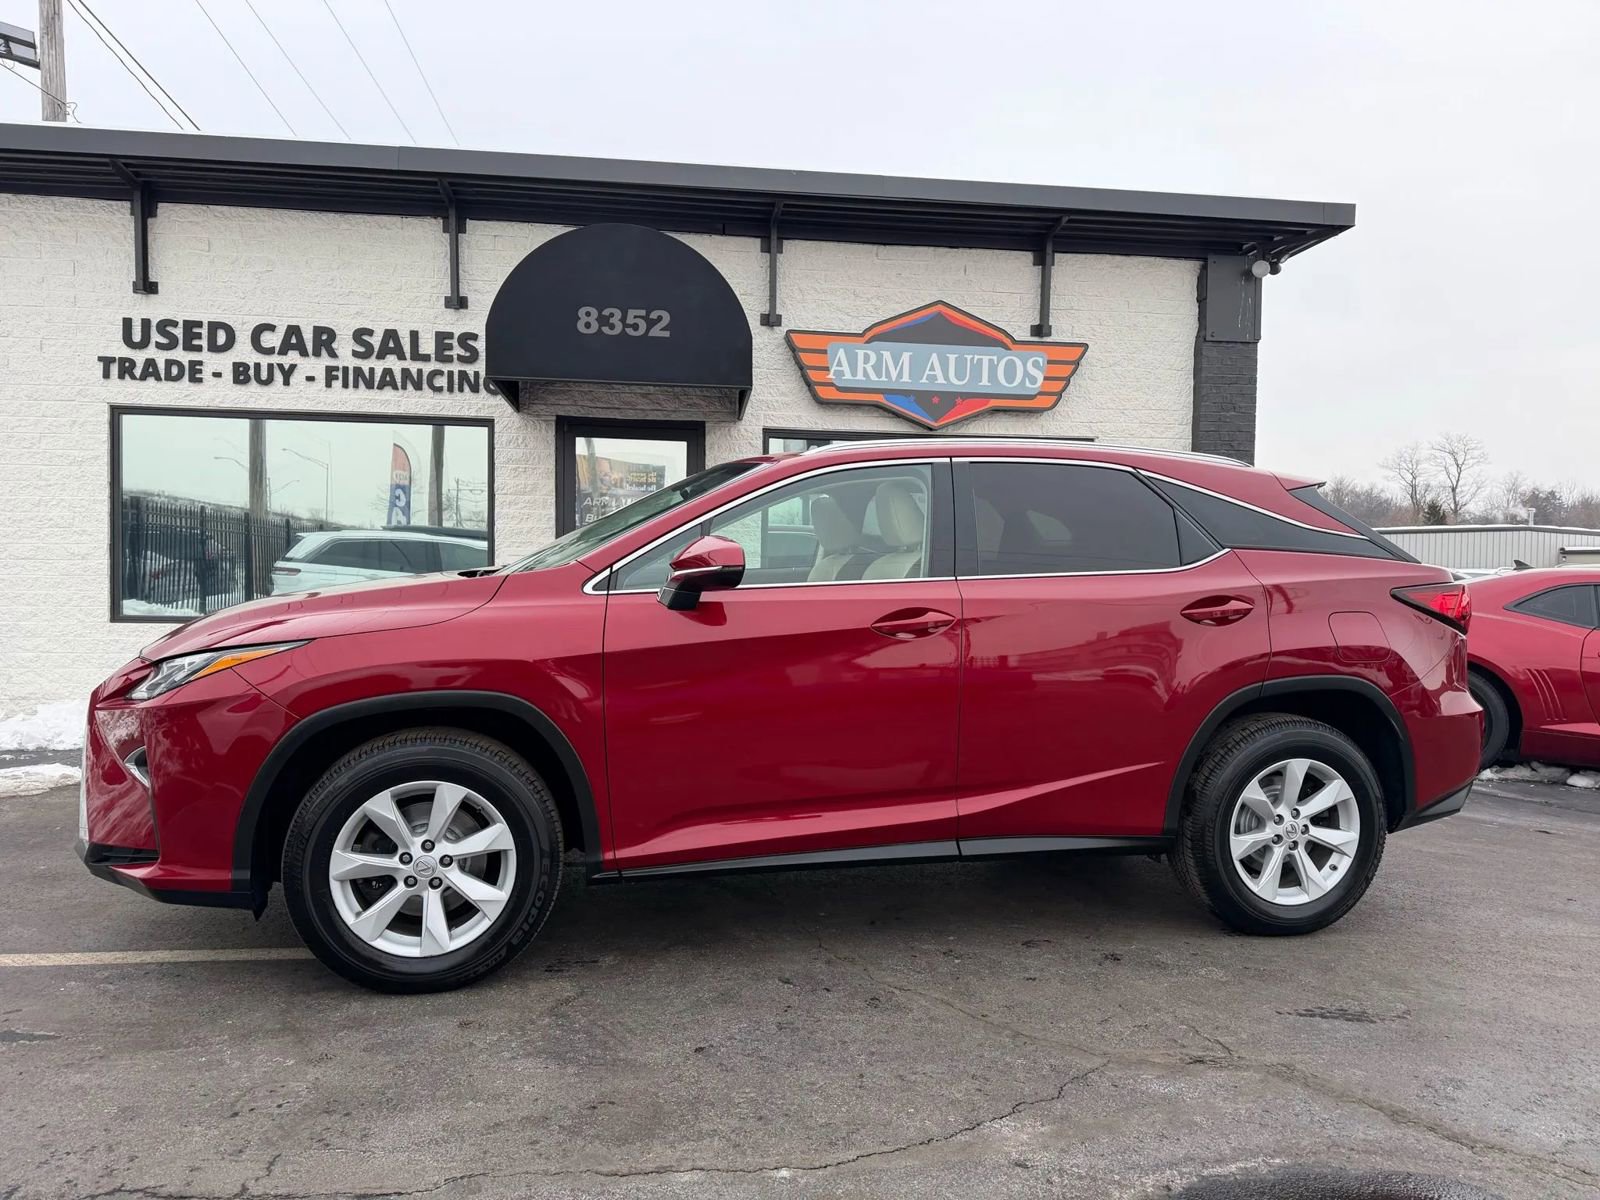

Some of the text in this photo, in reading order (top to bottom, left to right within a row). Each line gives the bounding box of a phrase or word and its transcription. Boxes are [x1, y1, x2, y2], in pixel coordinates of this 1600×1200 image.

[122, 317, 480, 364] USED CAR SALES
[576, 306, 671, 338] 8352
[97, 356, 204, 383] TRADE
[232, 361, 298, 386] BUY
[826, 347, 1044, 389] ARM AUTOS
